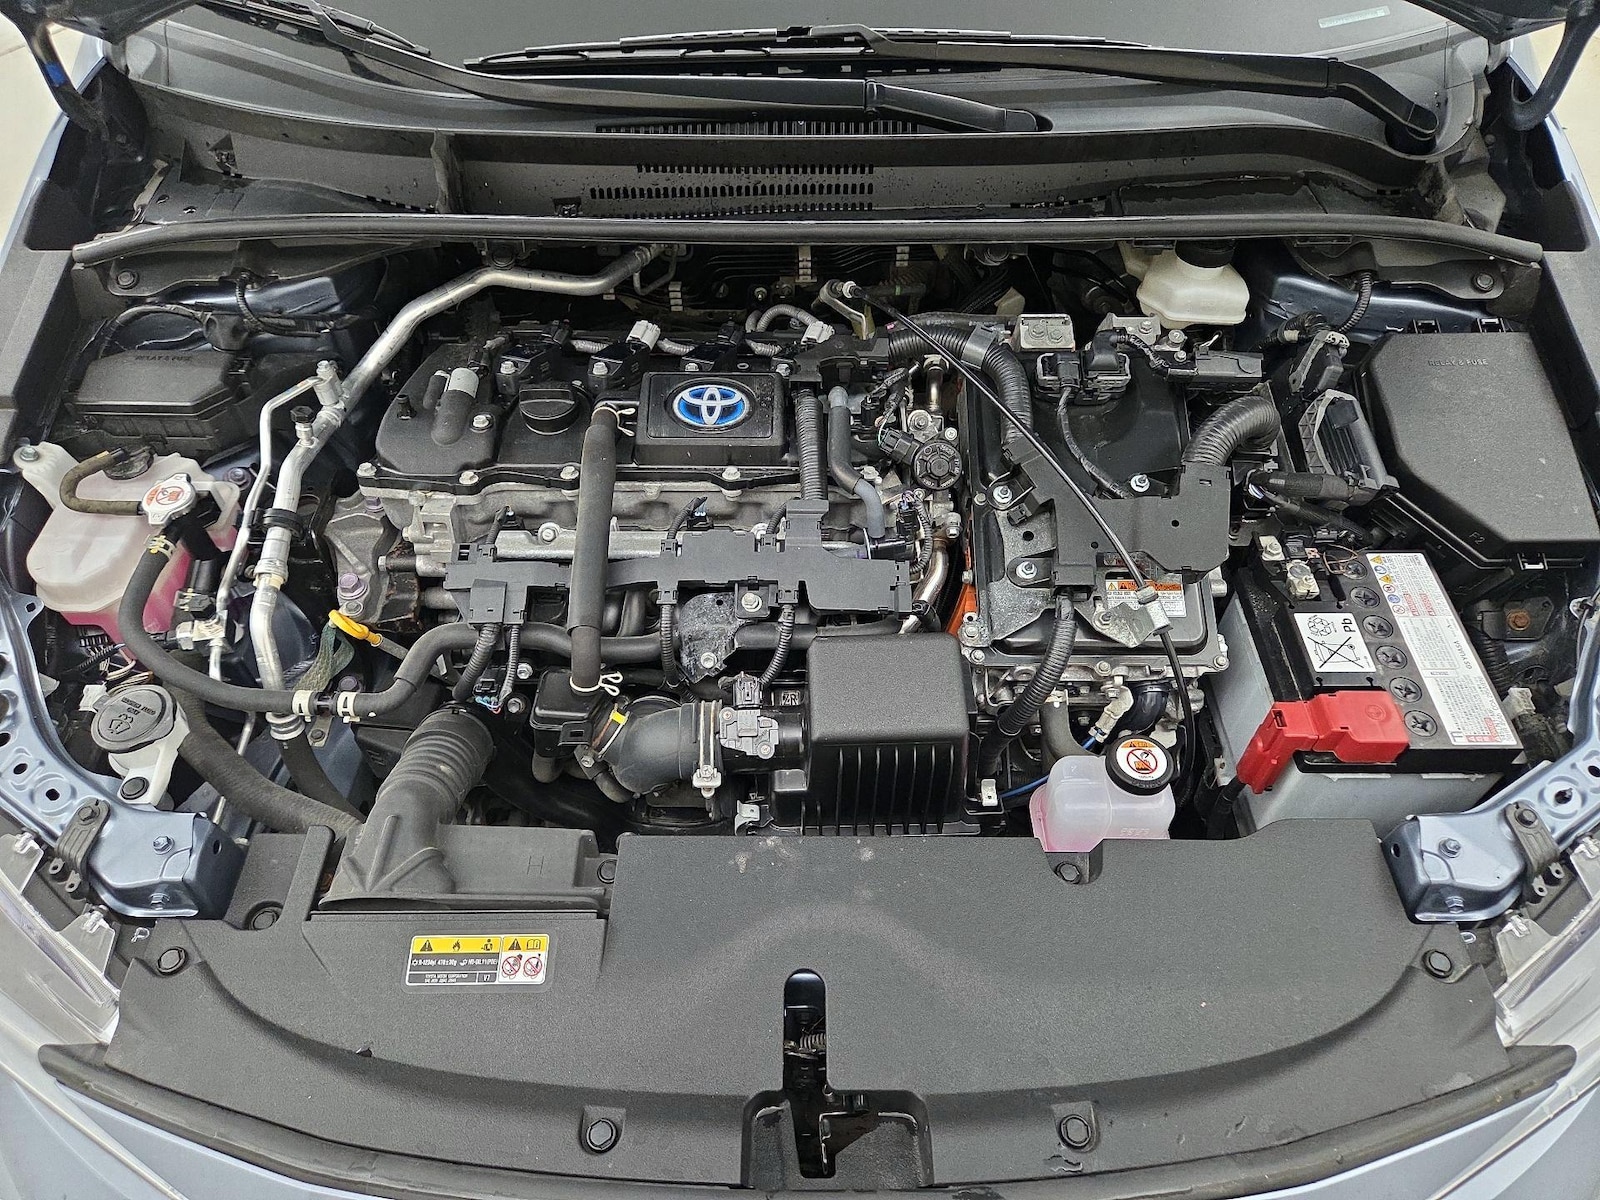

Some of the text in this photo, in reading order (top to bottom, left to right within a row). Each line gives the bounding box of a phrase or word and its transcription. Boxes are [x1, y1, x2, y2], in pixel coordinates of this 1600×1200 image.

[1427, 359, 1456, 367] RELAY
[1466, 358, 1489, 366] FUSE
[1341, 617, 1356, 634] Pb
[1452, 640, 1473, 670] GS YUASA
[526, 855, 545, 875] H
